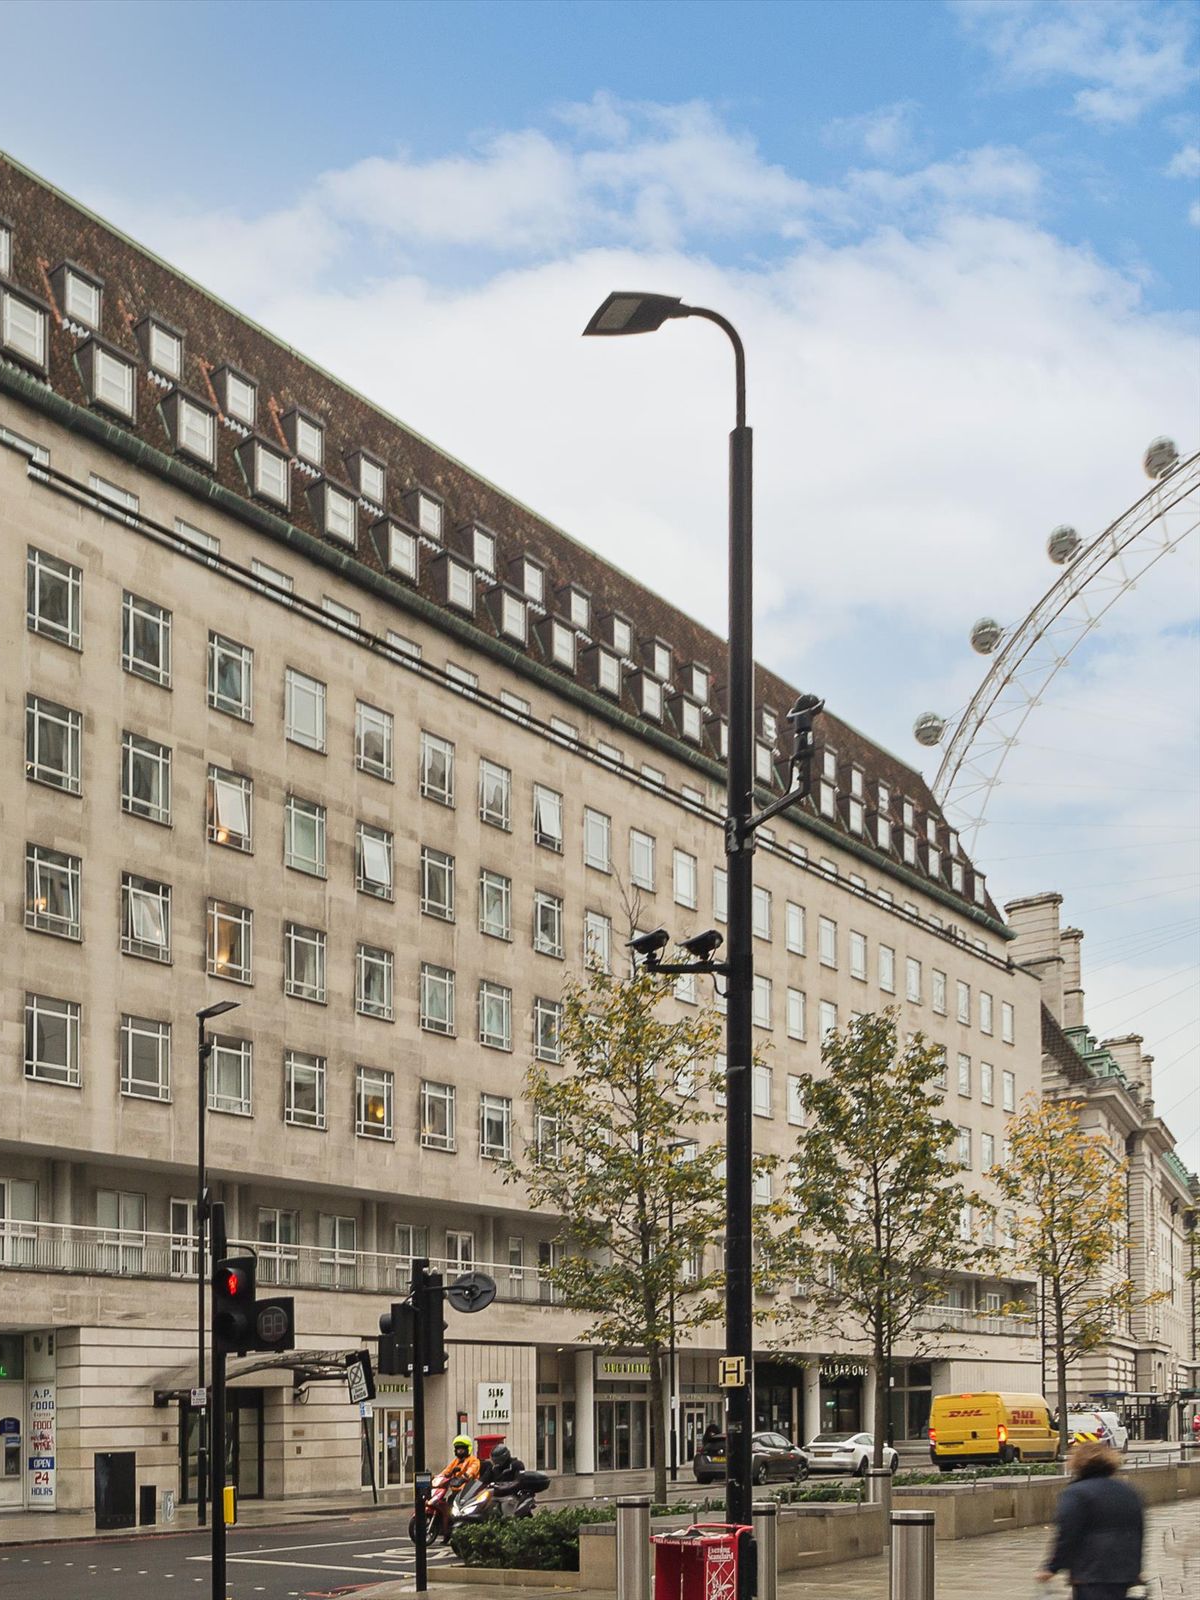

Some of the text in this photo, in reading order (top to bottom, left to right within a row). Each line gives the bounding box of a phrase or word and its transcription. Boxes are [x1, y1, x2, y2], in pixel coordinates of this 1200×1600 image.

[947, 1410, 984, 1418] DHL
[33, 1458, 51, 1469] OPEN
[34, 1471, 50, 1485] 24
[31, 1487, 53, 1496] HOURS
